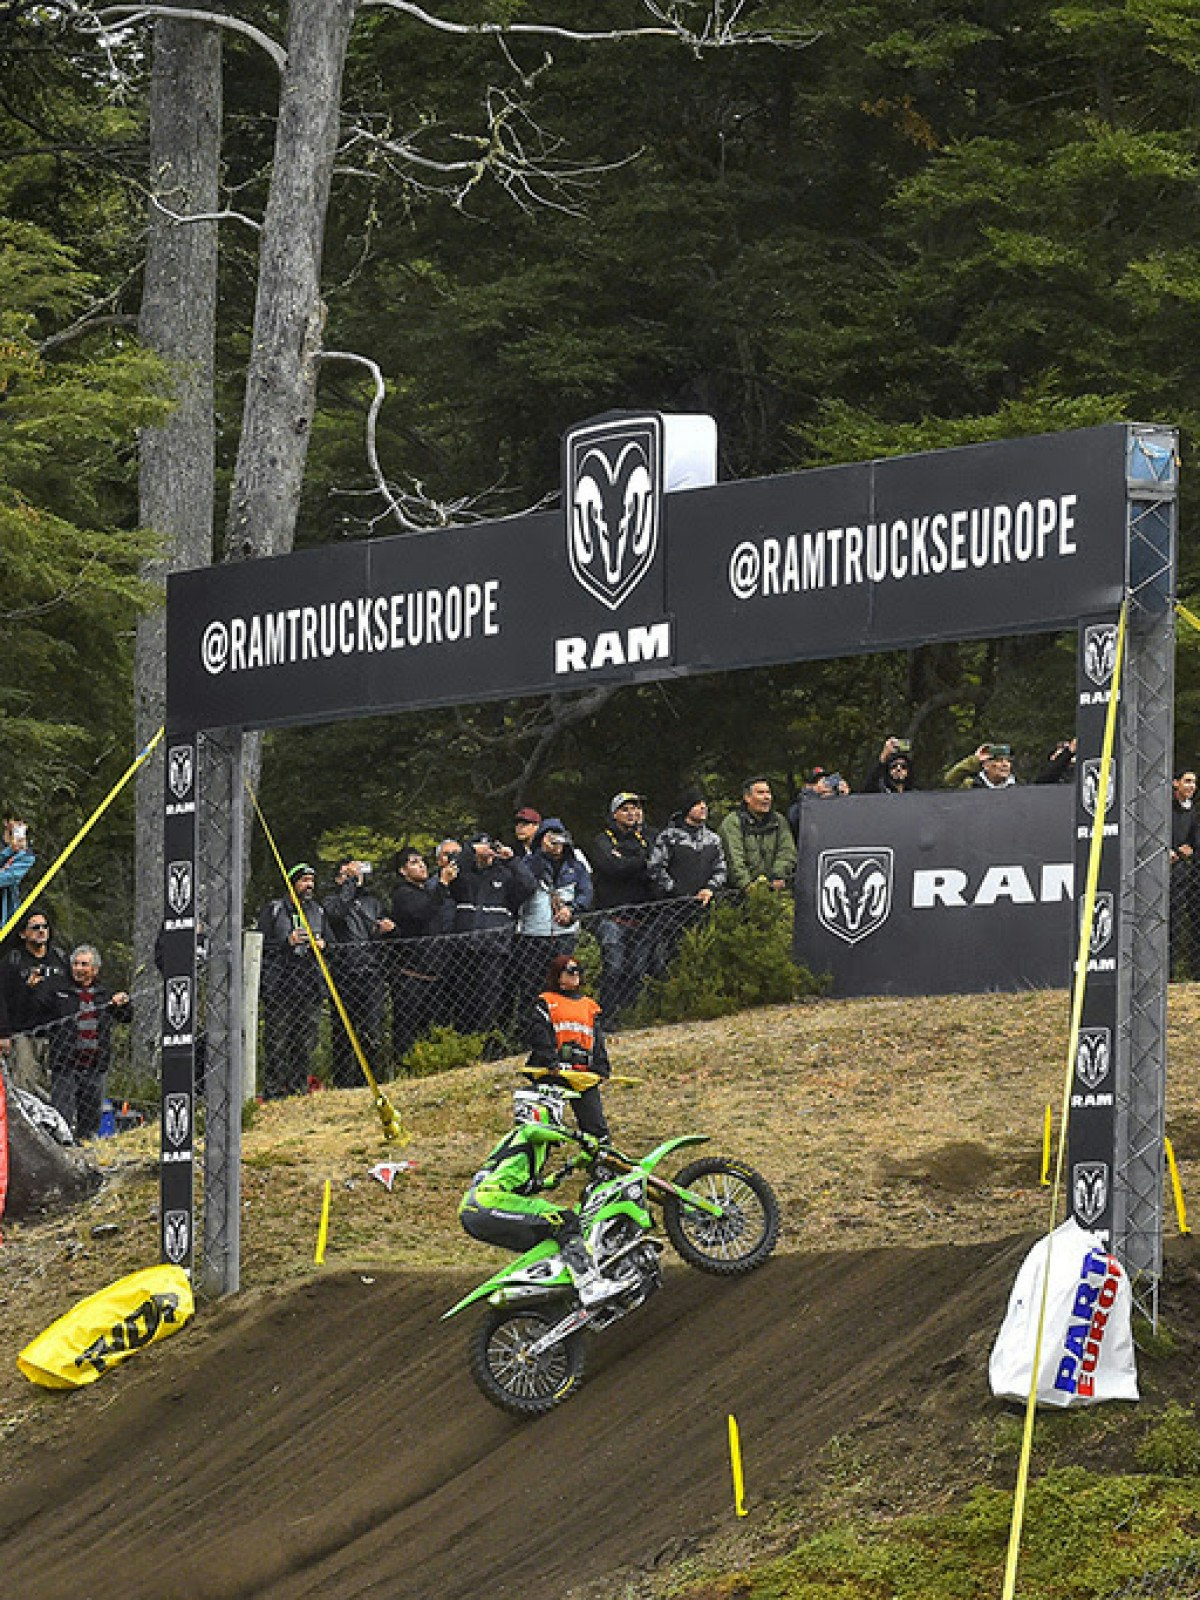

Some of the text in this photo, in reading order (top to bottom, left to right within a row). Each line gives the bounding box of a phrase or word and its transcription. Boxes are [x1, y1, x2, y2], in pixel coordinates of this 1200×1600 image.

[729, 494, 1077, 599] @RAMTRUCKSEUROPE
[202, 580, 500, 674] @RAMTRUCKSEUROPE
[554, 622, 670, 674] RAM
[1077, 823, 1118, 839] RM
[1070, 1093, 1113, 1107] RAM
[1055, 1248, 1107, 1394] PART
[1077, 1253, 1121, 1396] EUROP
